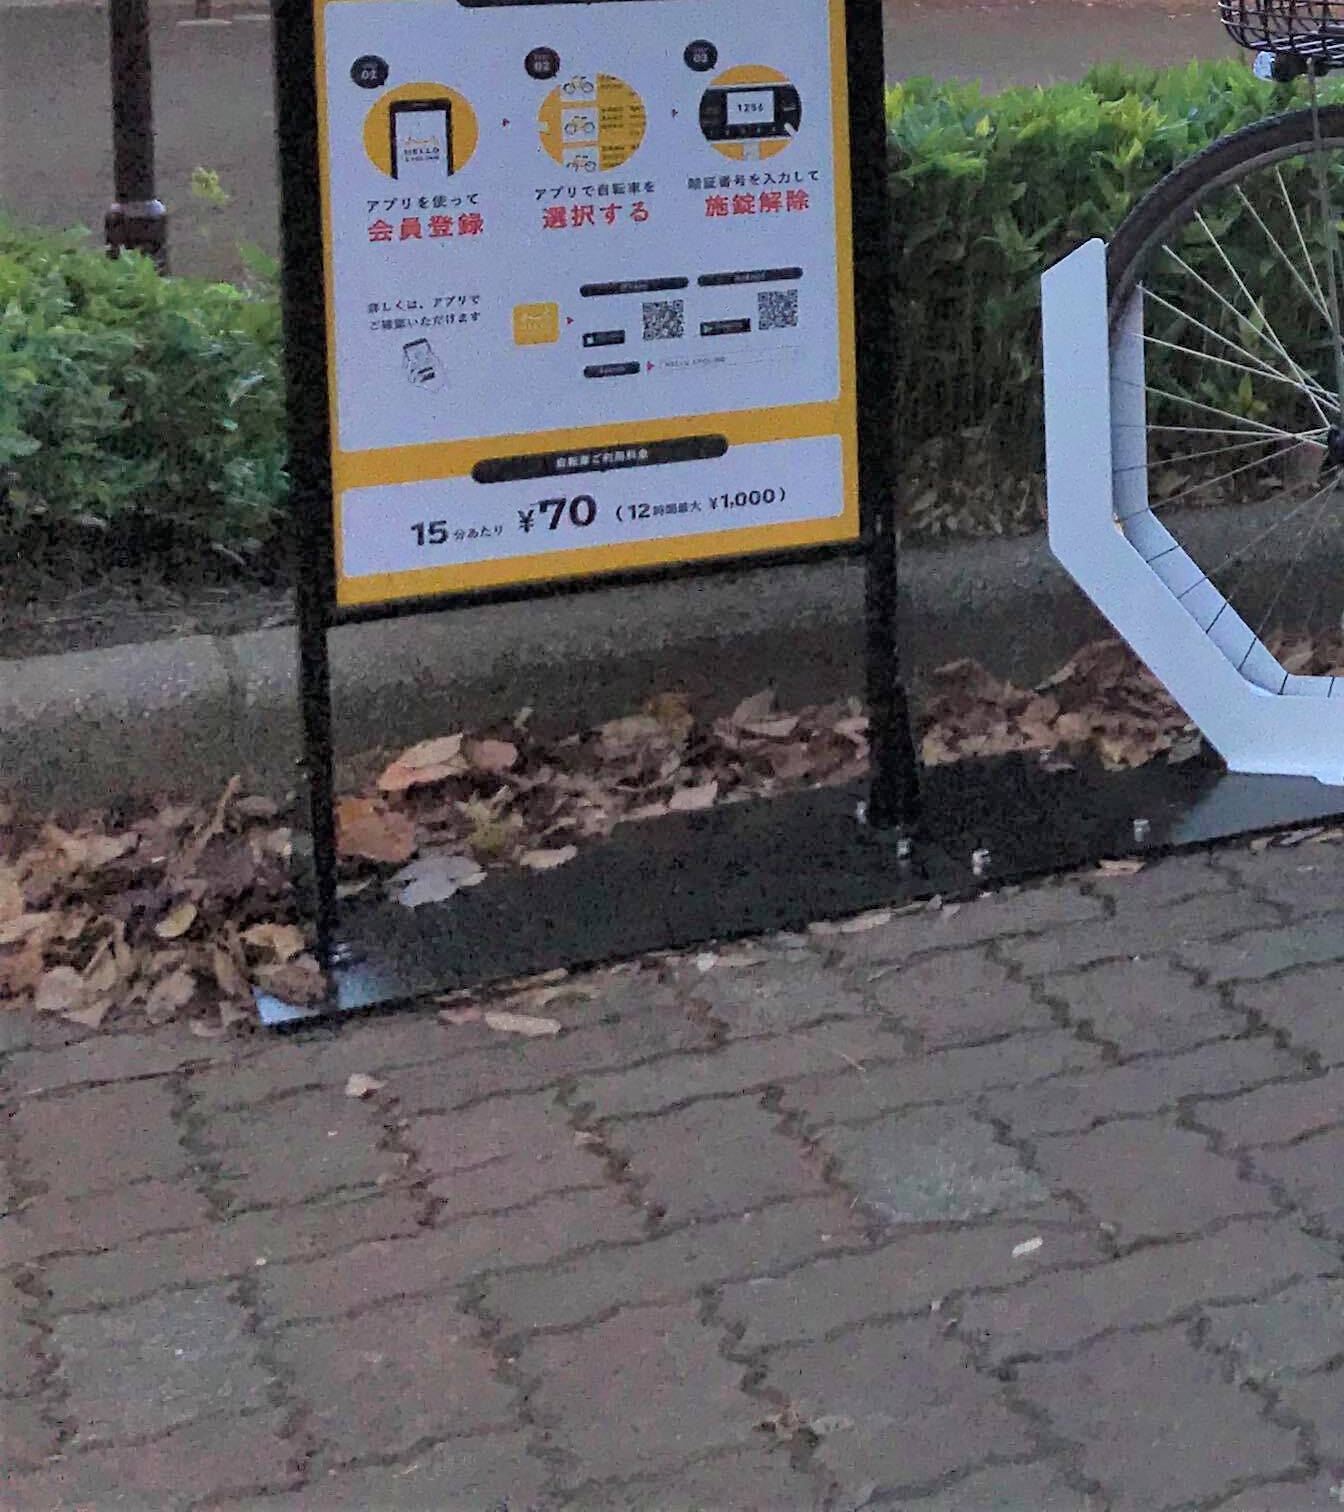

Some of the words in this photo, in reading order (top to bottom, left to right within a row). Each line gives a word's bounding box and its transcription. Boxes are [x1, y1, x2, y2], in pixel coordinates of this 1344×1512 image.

[361, 70, 377, 81] 01
[367, 193, 480, 212] アプリを使って
[535, 180, 656, 200] アプリで自転車を
[704, 189, 810, 218] 施錠解除
[367, 213, 484, 242] 会員登録
[542, 201, 649, 229] 選択する
[518, 494, 598, 533] ¥70
